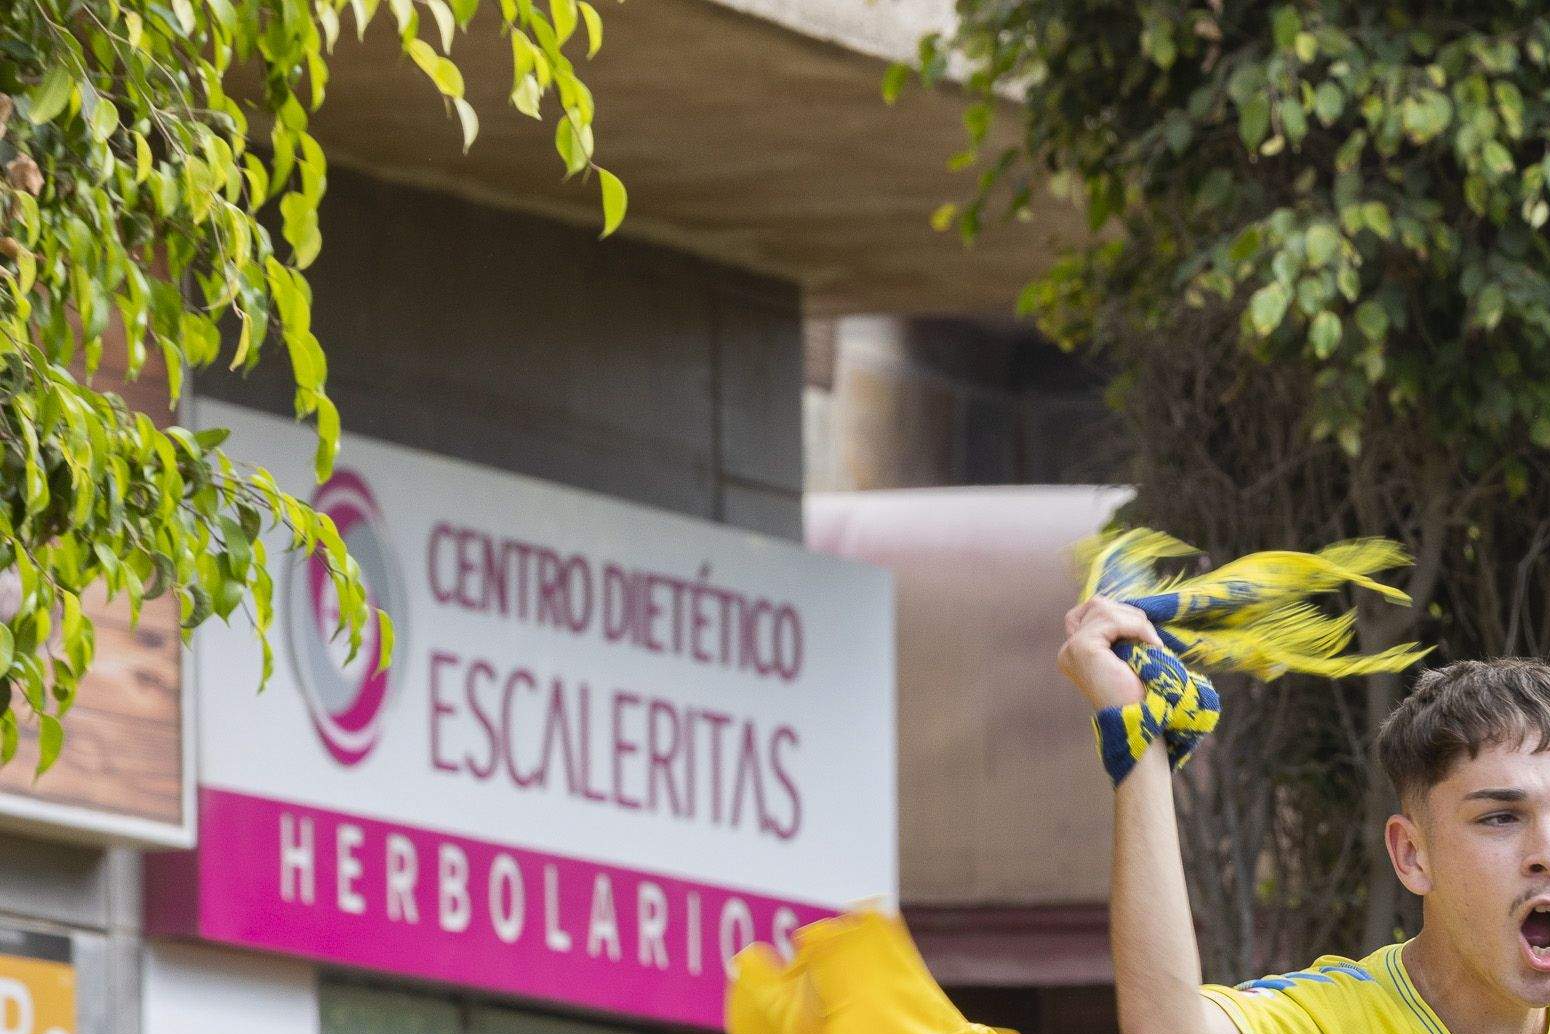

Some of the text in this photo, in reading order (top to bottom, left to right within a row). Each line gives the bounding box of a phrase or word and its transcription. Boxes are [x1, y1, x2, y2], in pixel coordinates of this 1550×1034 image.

[427, 521, 803, 683] CENTRO DIETÉTICO
[429, 649, 801, 840] ESCALERITAS
[278, 812, 798, 980] HERBOLARIOS
